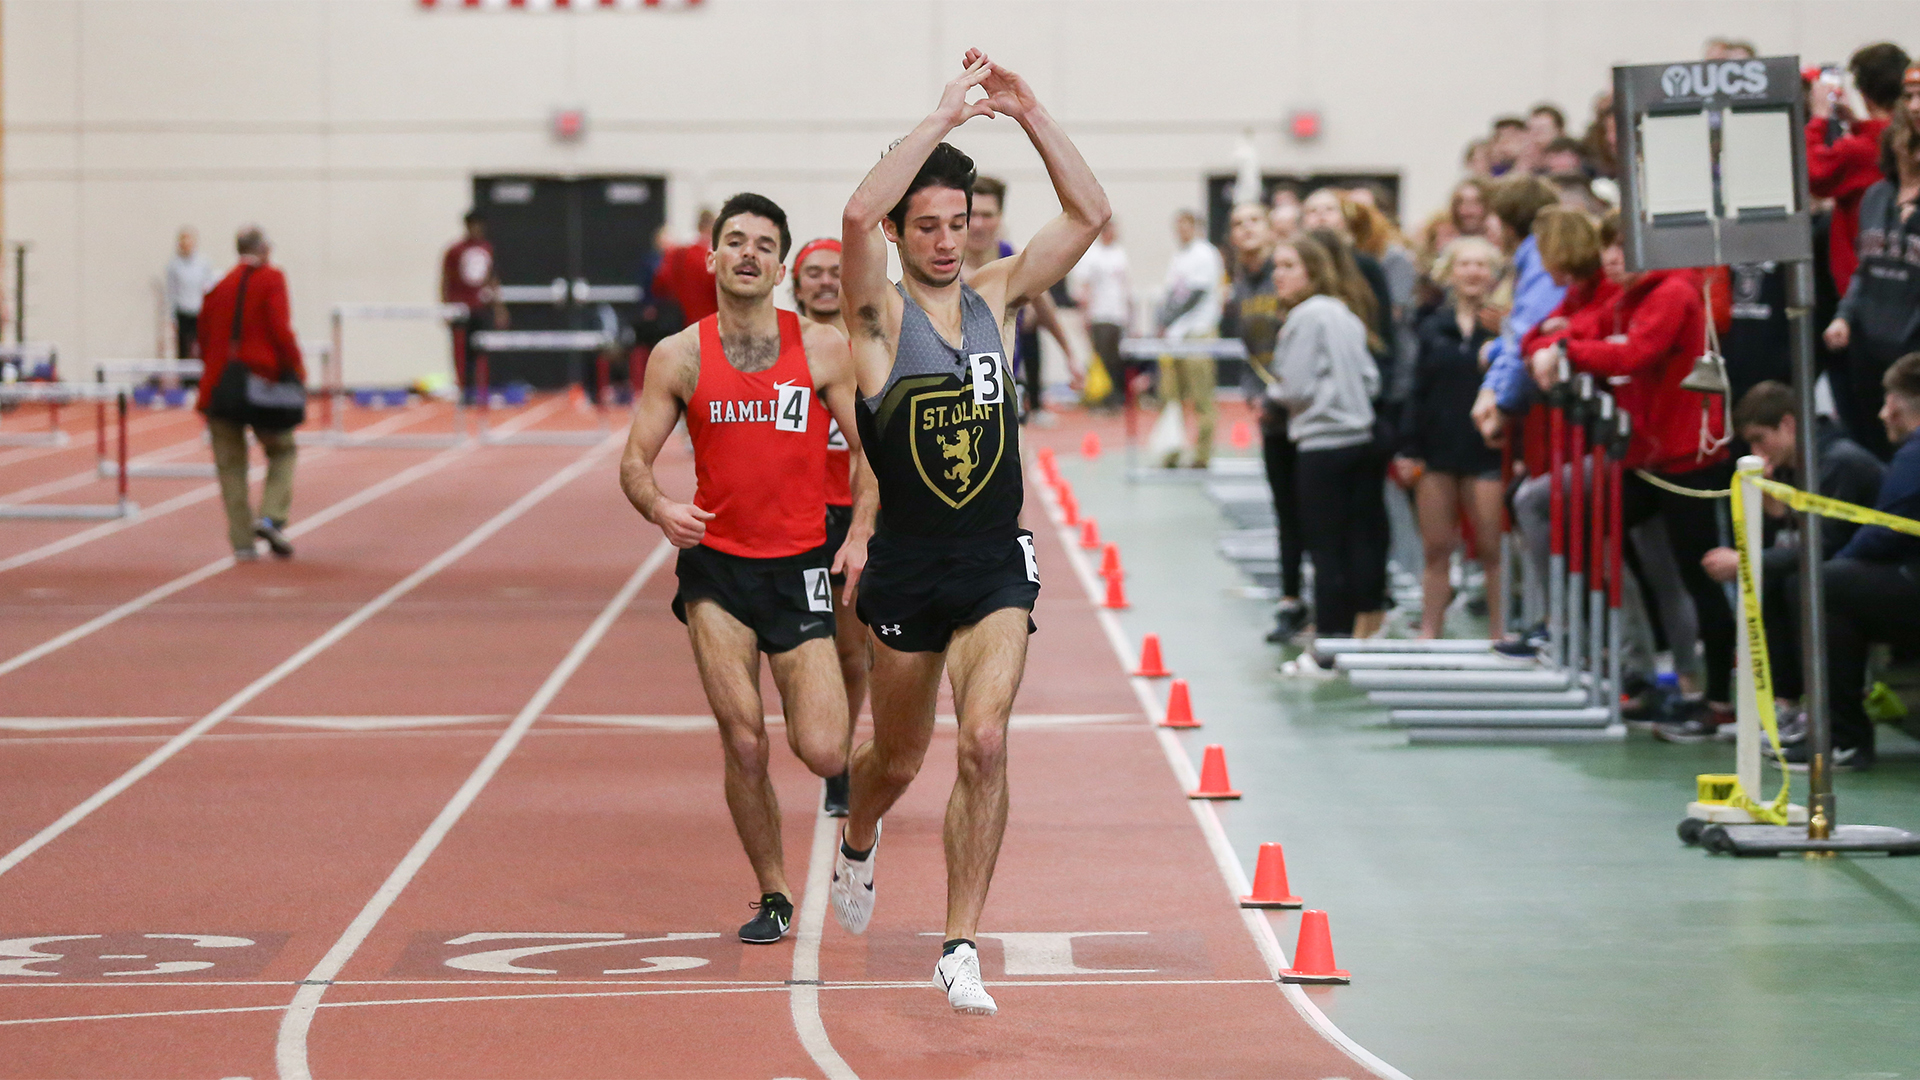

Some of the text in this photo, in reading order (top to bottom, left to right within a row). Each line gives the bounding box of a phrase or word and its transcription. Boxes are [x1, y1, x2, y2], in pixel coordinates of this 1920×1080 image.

[1691, 60, 1768, 96] UCS
[978, 355, 1000, 401] 3
[709, 400, 780, 423] HAMLI
[783, 390, 803, 429] 4
[923, 401, 993, 431] ST. OLAF
[813, 571, 831, 608] 4
[444, 932, 722, 975] 2
